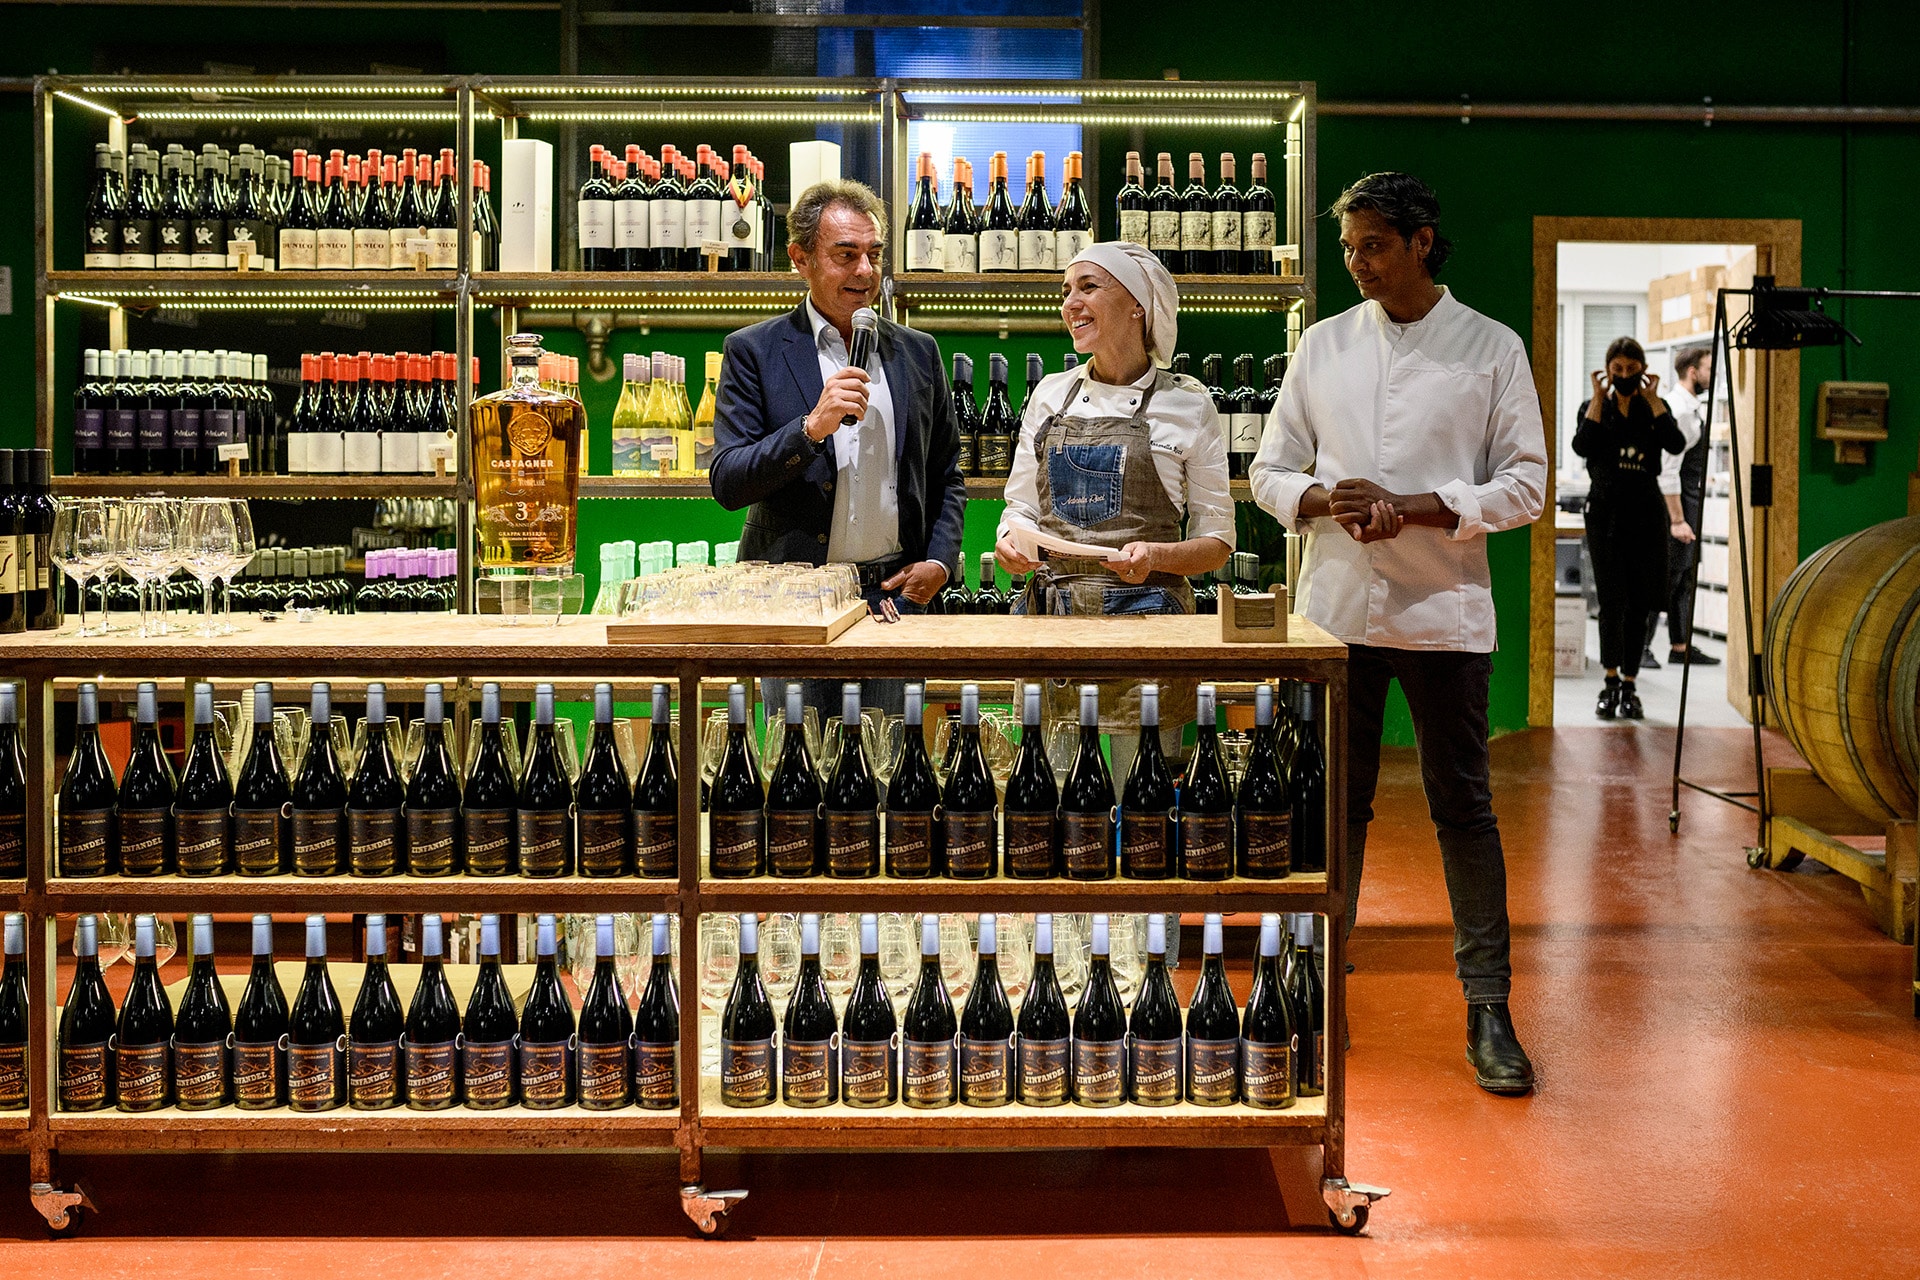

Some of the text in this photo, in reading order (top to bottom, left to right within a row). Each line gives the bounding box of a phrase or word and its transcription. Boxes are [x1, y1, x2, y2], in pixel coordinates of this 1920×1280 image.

[490, 459, 553, 468] CASTAGNER
[62, 837, 106, 854] ZINFANDEL
[121, 837, 163, 852] ZINFANDEL
[178, 837, 222, 854] ZINFANDEL
[294, 838, 337, 854] ZINFANDEL
[351, 838, 393, 854] ZINFANDEL
[411, 837, 454, 854] ZINFANDEL
[468, 837, 510, 853] ZINFANDEL
[520, 839, 561, 854] ZINFANDEL
[584, 837, 625, 854] ZINFANDEL
[637, 840, 677, 855] ZINFANDEL
[716, 839, 758, 855] ZINFANDEL
[770, 839, 808, 854] ZINFANDEL
[829, 839, 870, 855] ZINFANDEL
[887, 840, 925, 855] ZINFANDEL
[946, 840, 987, 855] ZINFANDEL
[1009, 841, 1049, 855] ZINFANDEL
[1063, 841, 1103, 855] ZINFANDEL
[1185, 842, 1226, 856] ZINFANDEL
[1247, 839, 1288, 855] ZINFANDEL
[119, 1072, 162, 1088] ZINFANDEL
[176, 1070, 217, 1086] ZINFANDEL
[288, 1073, 328, 1087] ZINFANDEL
[350, 1071, 390, 1086] ZINFANDEL
[408, 1071, 449, 1086] ZINFANDEL
[465, 1070, 504, 1086] ZINFANDEL
[520, 1071, 559, 1085] ZINFANDEL
[580, 1071, 622, 1086] ZINFANDEL
[635, 1071, 672, 1085] ZINFANDEL
[723, 1069, 764, 1083] ZINFANDEL
[784, 1069, 822, 1083] ZINFANDEL
[844, 1069, 883, 1084] ZINFANDEL
[906, 1069, 947, 1084] ZINFANDEL
[961, 1069, 1000, 1083] ZINFANDEL
[1025, 1067, 1066, 1084] ZINFANDEL
[1077, 1069, 1117, 1085] ZINFANDEL
[1136, 1068, 1177, 1084] ZINFANDEL
[1194, 1067, 1235, 1084] ZINFANDEL
[1244, 1071, 1284, 1085] ZINFANDEL
